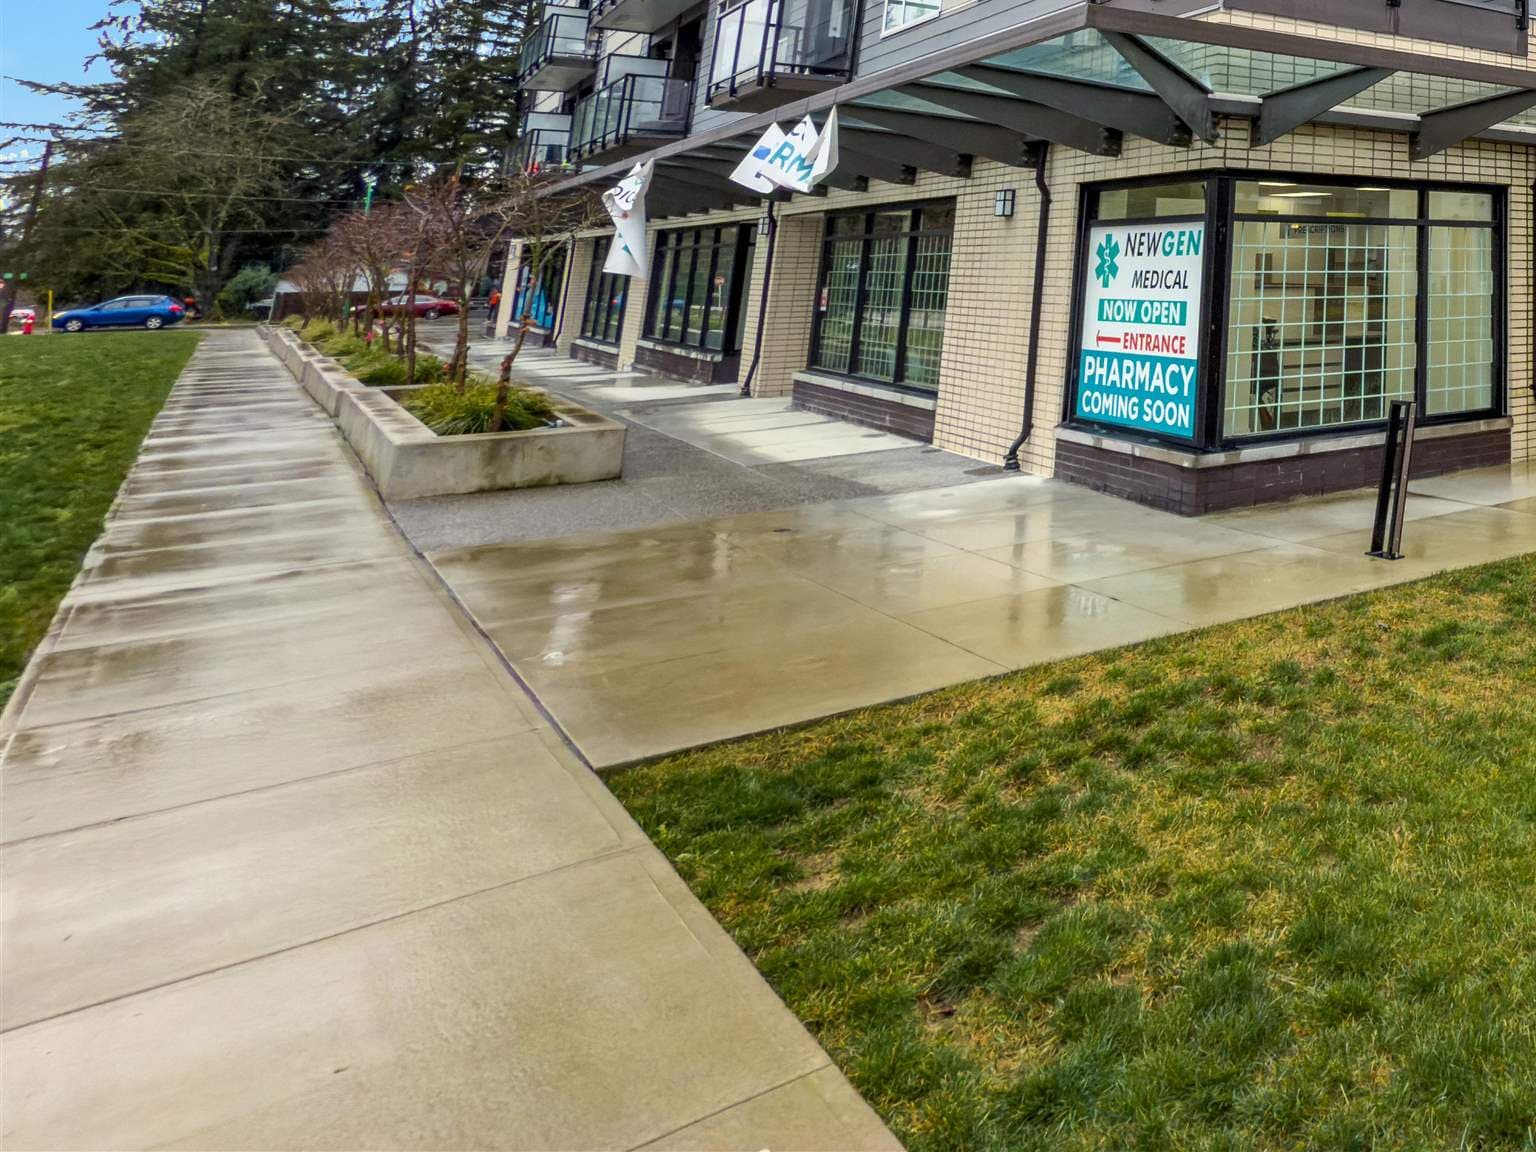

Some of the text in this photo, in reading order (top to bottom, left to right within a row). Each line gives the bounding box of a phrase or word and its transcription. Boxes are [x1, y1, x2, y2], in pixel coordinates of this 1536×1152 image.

[1293, 223, 1345, 235] RECRIPTIONS
[1124, 230, 1202, 257] NEWGEN
[1131, 269, 1189, 289] MEDICAL
[1103, 299, 1181, 324] NOW OPEN
[1122, 332, 1186, 355] ENTRANCE
[1083, 355, 1195, 397] PHARMACY
[1081, 390, 1190, 428] COMING SOON
